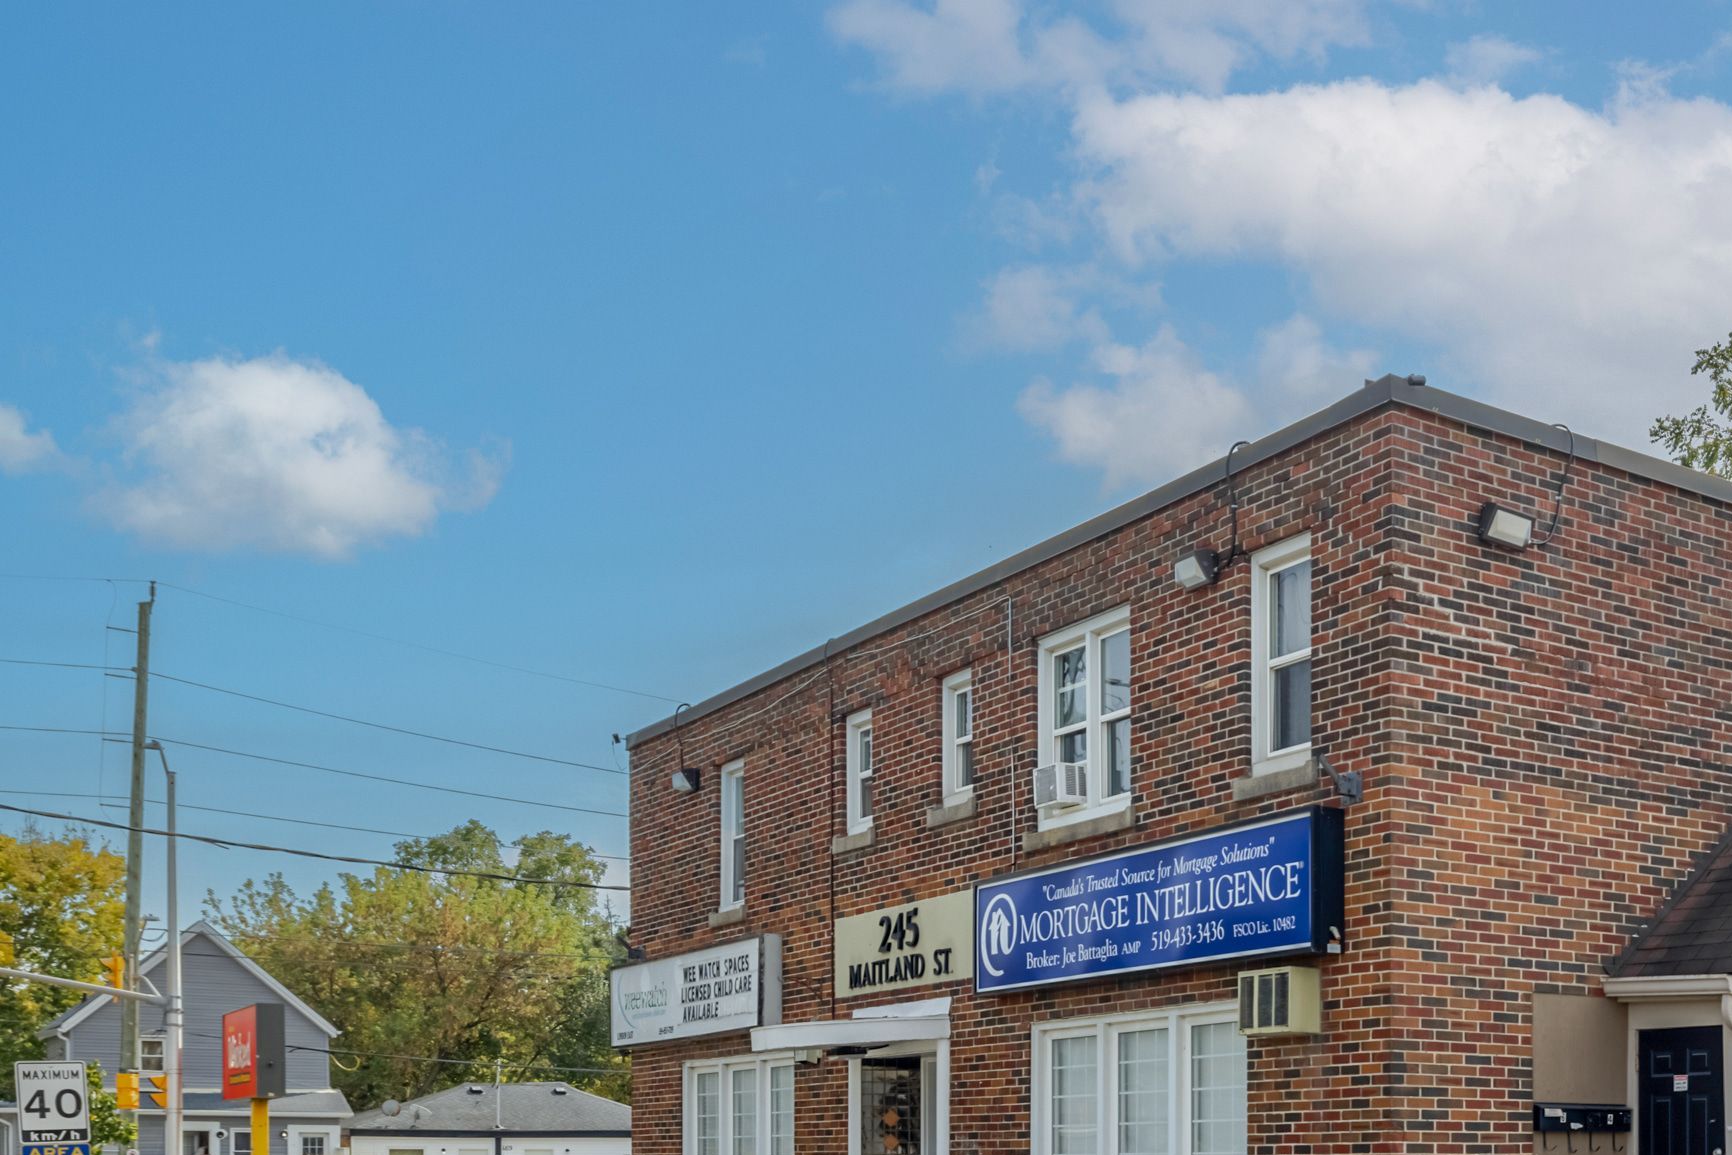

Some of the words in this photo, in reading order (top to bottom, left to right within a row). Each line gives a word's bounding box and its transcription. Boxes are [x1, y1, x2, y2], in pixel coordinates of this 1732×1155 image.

[1042, 877, 1084, 902] "Canada's
[1087, 869, 1118, 892] Trusted
[1122, 867, 1154, 886] Source
[1157, 858, 1171, 884] for
[1173, 853, 1218, 877] Mortgage
[1220, 836, 1275, 865] Solutions"
[878, 907, 920, 953] 245
[1019, 895, 1130, 944] MORTGAGE
[1026, 952, 1061, 969] Broker:
[1061, 947, 1076, 968] Joe
[1078, 939, 1118, 962] Battaglia
[1121, 940, 1141, 956] AMP
[1151, 919, 1225, 951] 519-433-3436
[1233, 922, 1256, 938] FSCO
[1257, 920, 1271, 934] Lic.
[1273, 915, 1296, 933] 10482
[683, 966, 696, 984] WEE
[698, 960, 720, 980] WATCH
[724, 954, 749, 976] SPACES
[849, 953, 925, 990] MAITLAND
[681, 983, 711, 1003] LICENSED
[714, 979, 733, 998] CHILD
[735, 975, 752, 994] CARE
[683, 1002, 719, 1023] AVAILABLE
[22, 1070, 79, 1080] MAXIMUM
[24, 1089, 82, 1118] 40
[30, 1130, 80, 1141] km/h
